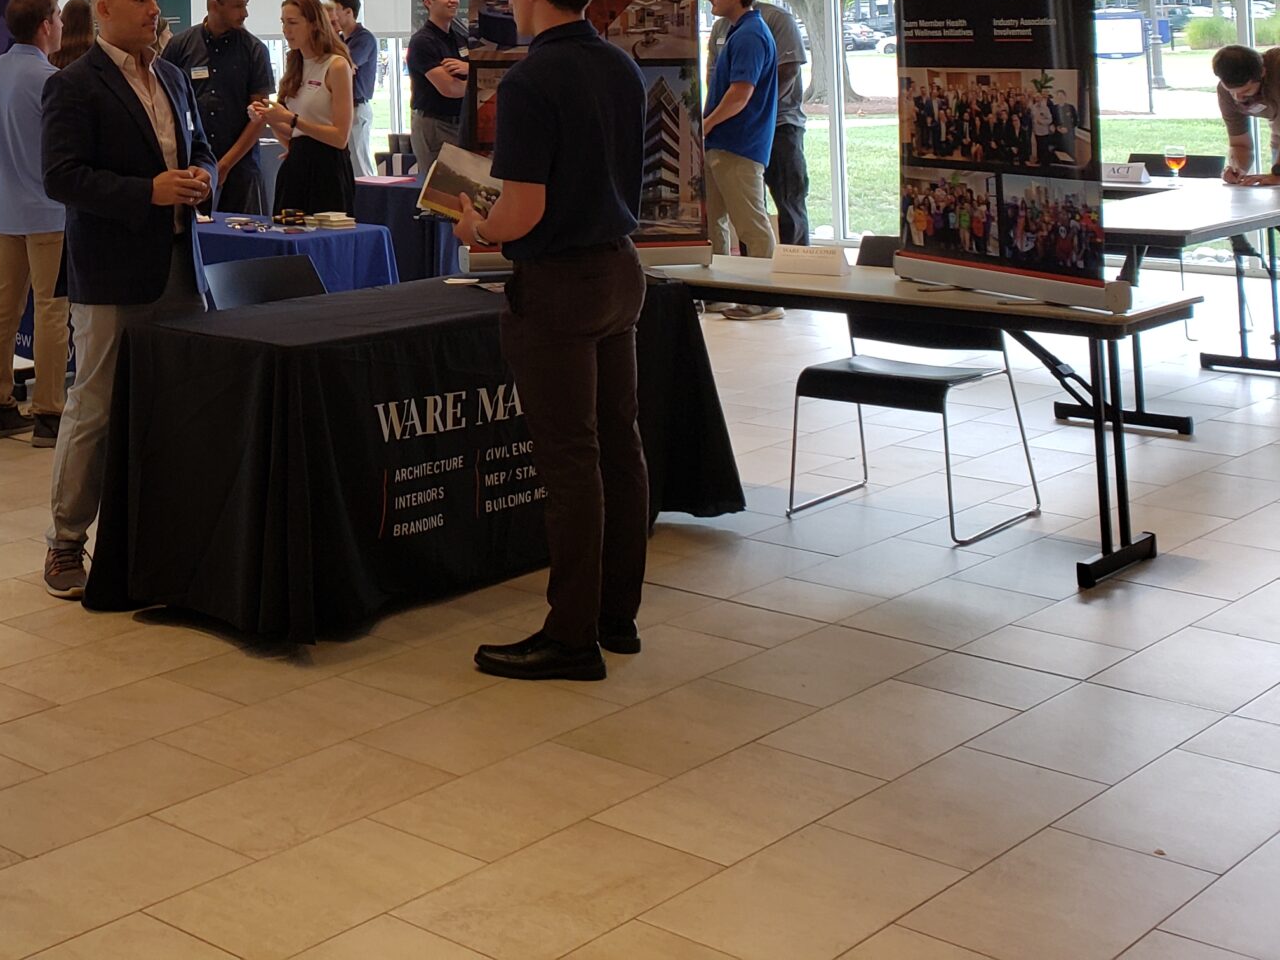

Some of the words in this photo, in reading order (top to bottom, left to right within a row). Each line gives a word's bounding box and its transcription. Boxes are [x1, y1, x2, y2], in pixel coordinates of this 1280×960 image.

[923, 19, 946, 28] Member
[946, 18, 967, 27] Health
[993, 18, 1019, 27] Industry
[1020, 17, 1057, 26] Association
[914, 28, 942, 37] Wellness
[943, 28, 974, 37] Initiatives
[993, 28, 1032, 36] Involvement
[15, 332, 31, 348] ew
[374, 390, 467, 443] WARE
[486, 444, 510, 462] CIVIL
[394, 455, 464, 484] ARCHITECTURE
[485, 471, 506, 487] MEP
[394, 486, 445, 510] INTERIORS
[485, 490, 532, 513] BUILDING
[393, 513, 444, 537] BRANDING
